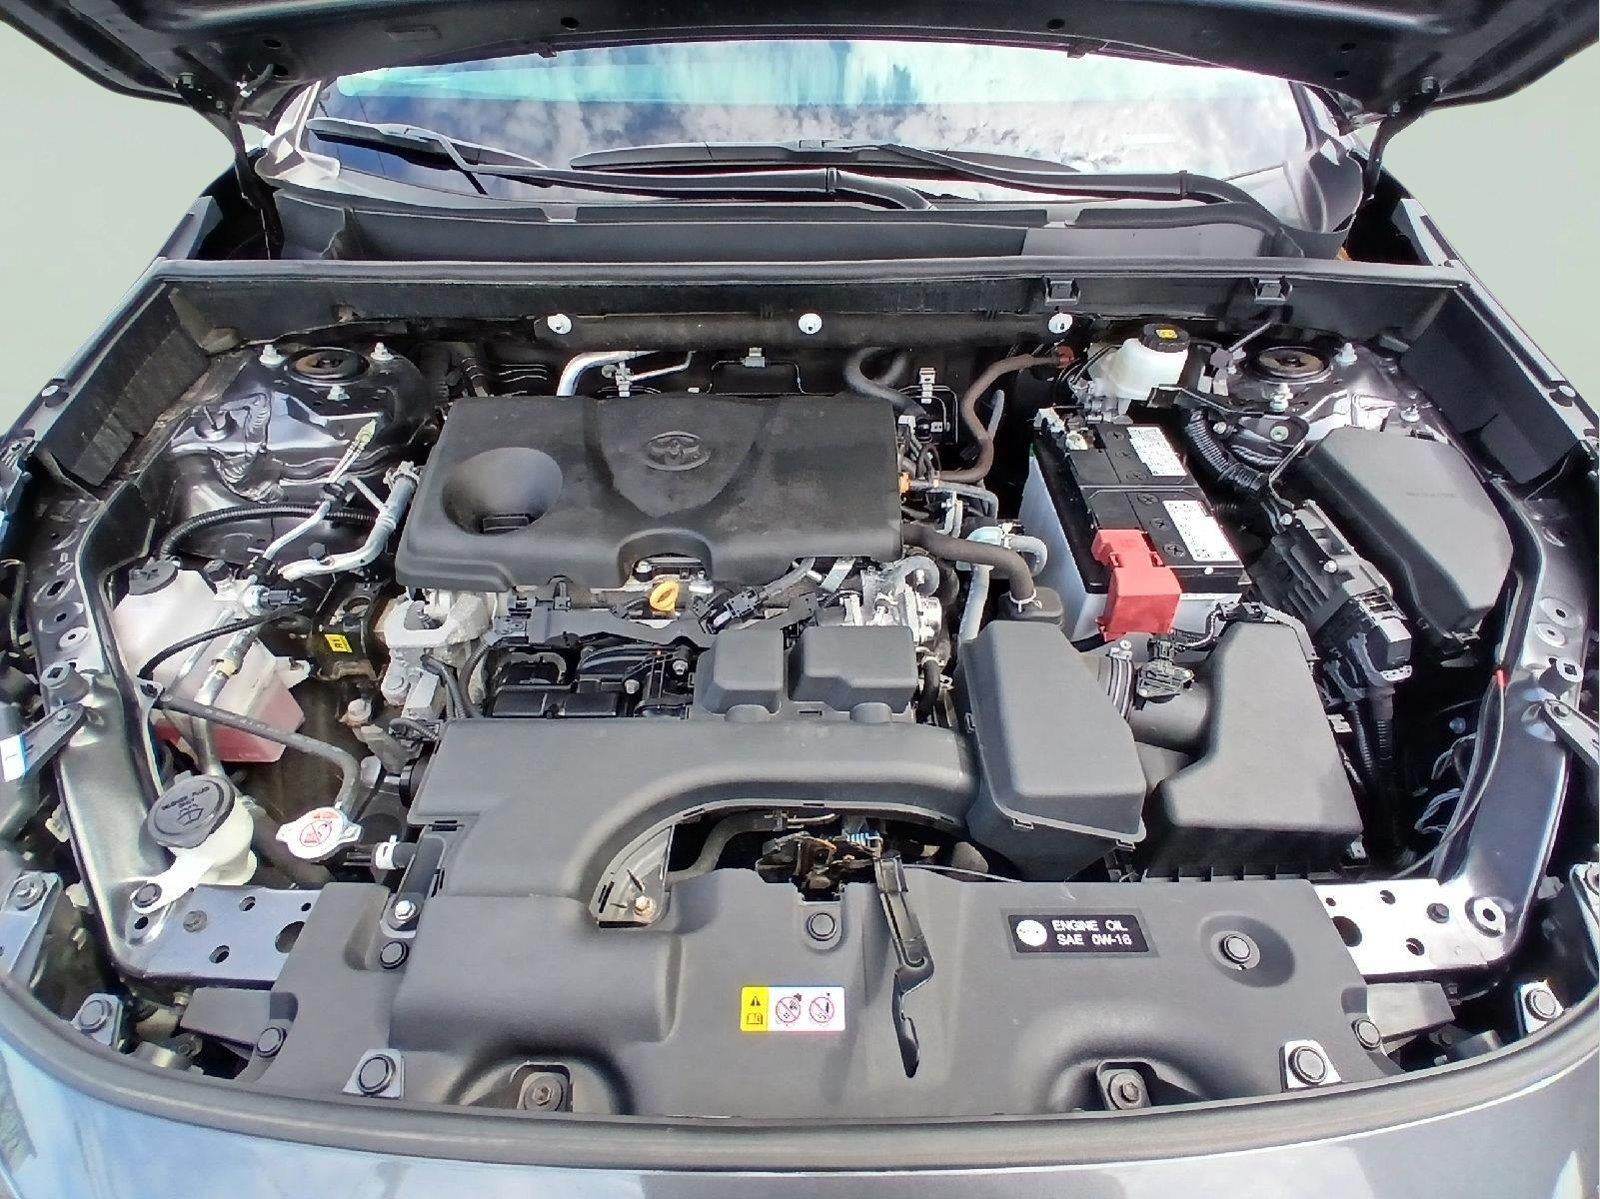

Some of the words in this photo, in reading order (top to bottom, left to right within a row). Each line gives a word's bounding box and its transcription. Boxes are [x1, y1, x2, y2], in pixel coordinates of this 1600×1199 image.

[1051, 919, 1099, 932] ENGINE
[1105, 919, 1129, 932] OIL
[1056, 933, 1085, 946] SAE
